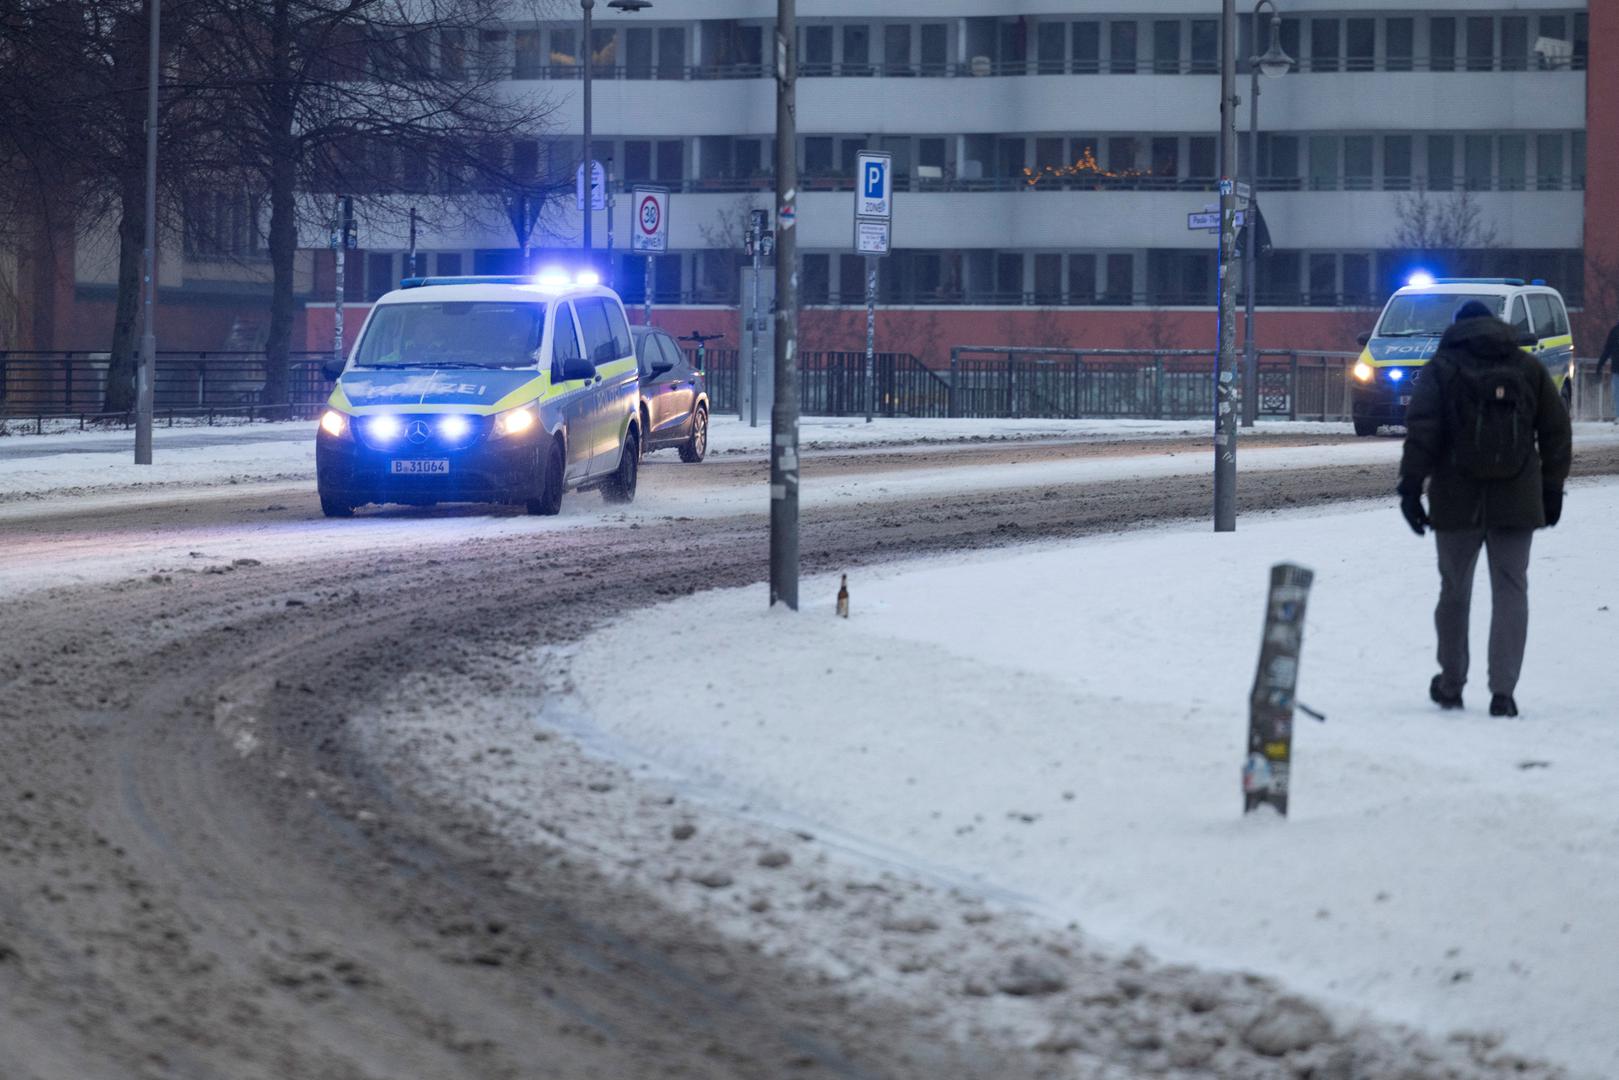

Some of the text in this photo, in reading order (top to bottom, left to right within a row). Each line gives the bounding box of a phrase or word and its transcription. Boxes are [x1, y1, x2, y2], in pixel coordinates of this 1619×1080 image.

[869, 167, 880, 193] P
[1385, 344, 1438, 354] POLI
[367, 383, 488, 398] POIZEI
[395, 462, 445, 472] B 31064
